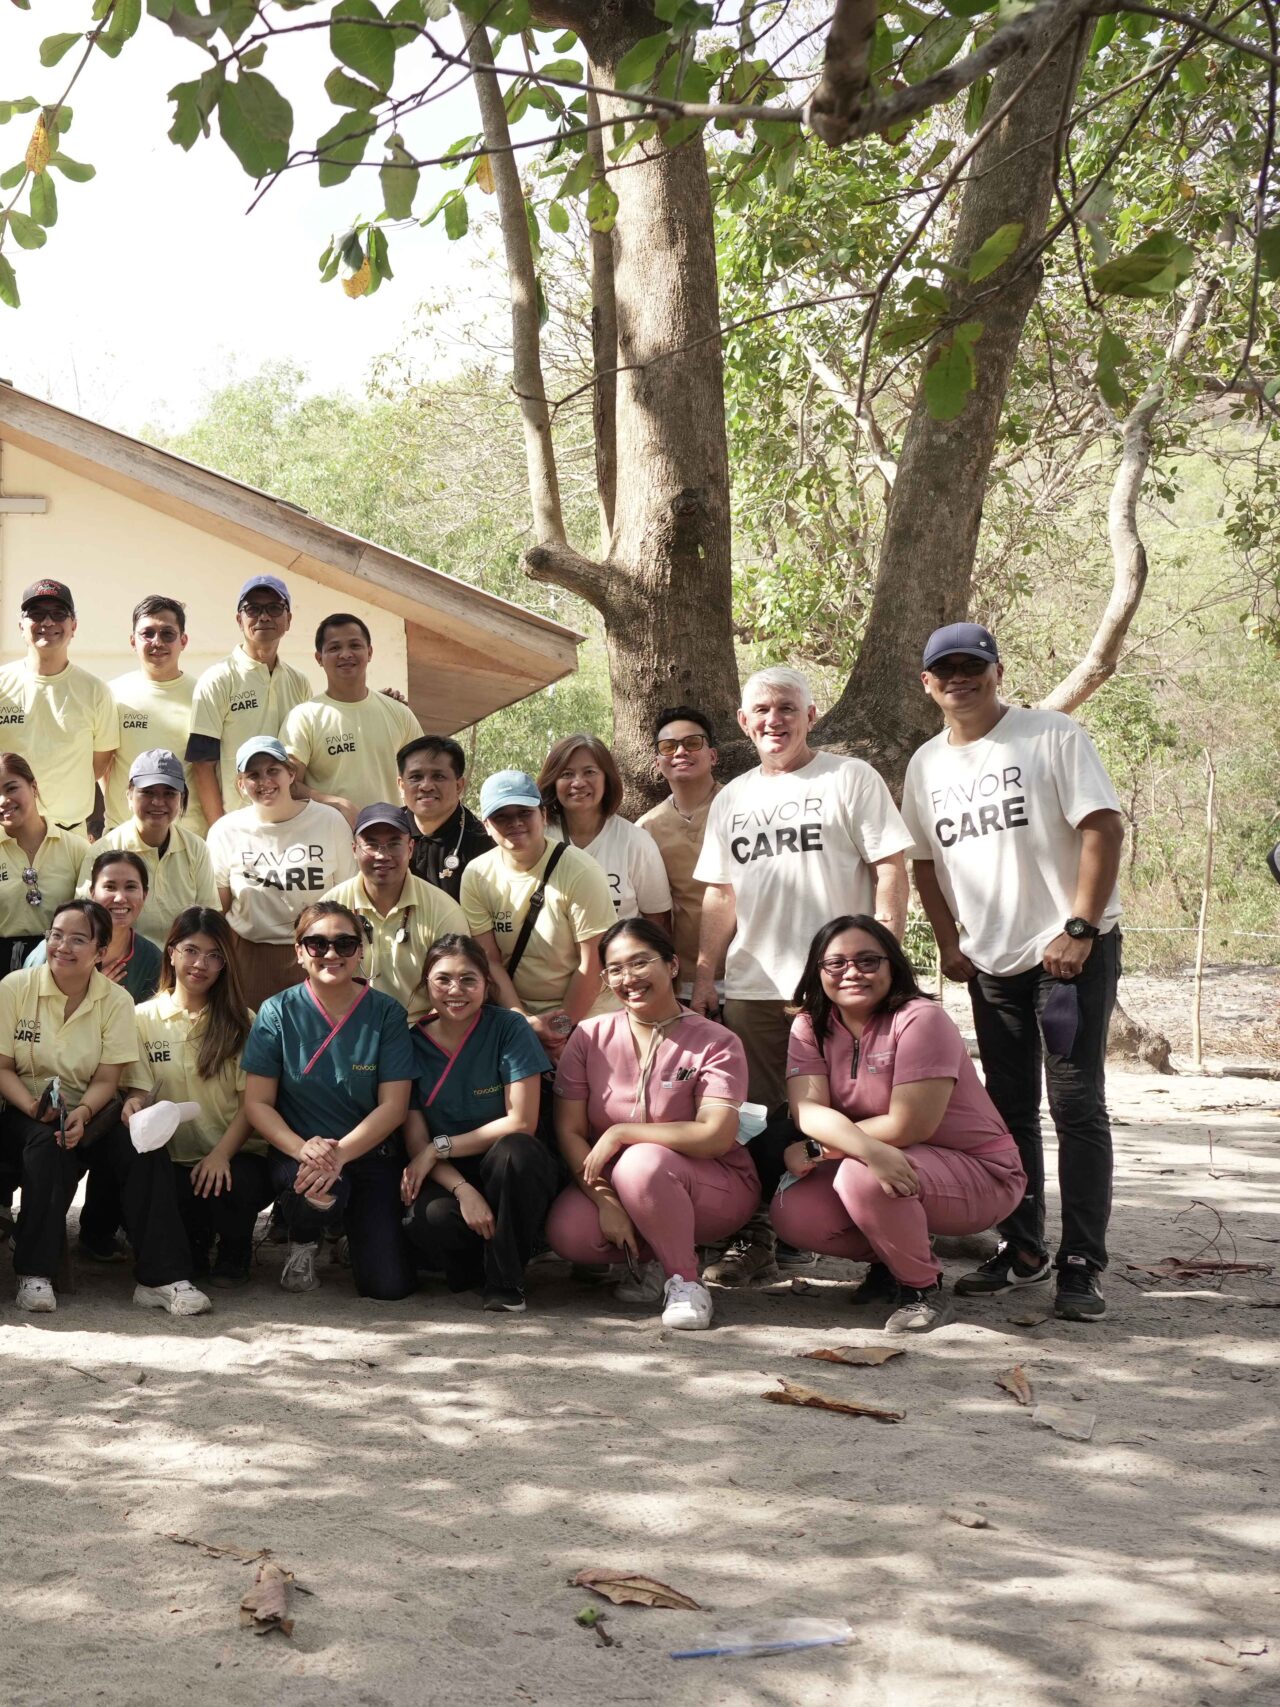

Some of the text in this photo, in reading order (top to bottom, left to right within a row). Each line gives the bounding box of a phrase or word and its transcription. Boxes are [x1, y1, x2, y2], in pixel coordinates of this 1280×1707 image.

[230, 699, 259, 712] CARE
[123, 721, 148, 729] CARE
[327, 742, 356, 756] CARE
[931, 766, 1023, 814] FAVOR
[731, 797, 823, 833] FAVOR
[935, 796, 1029, 848] CARE
[731, 823, 823, 864] CARE
[241, 845, 324, 867] FAVOR
[148, 1050, 171, 1063] ARE
